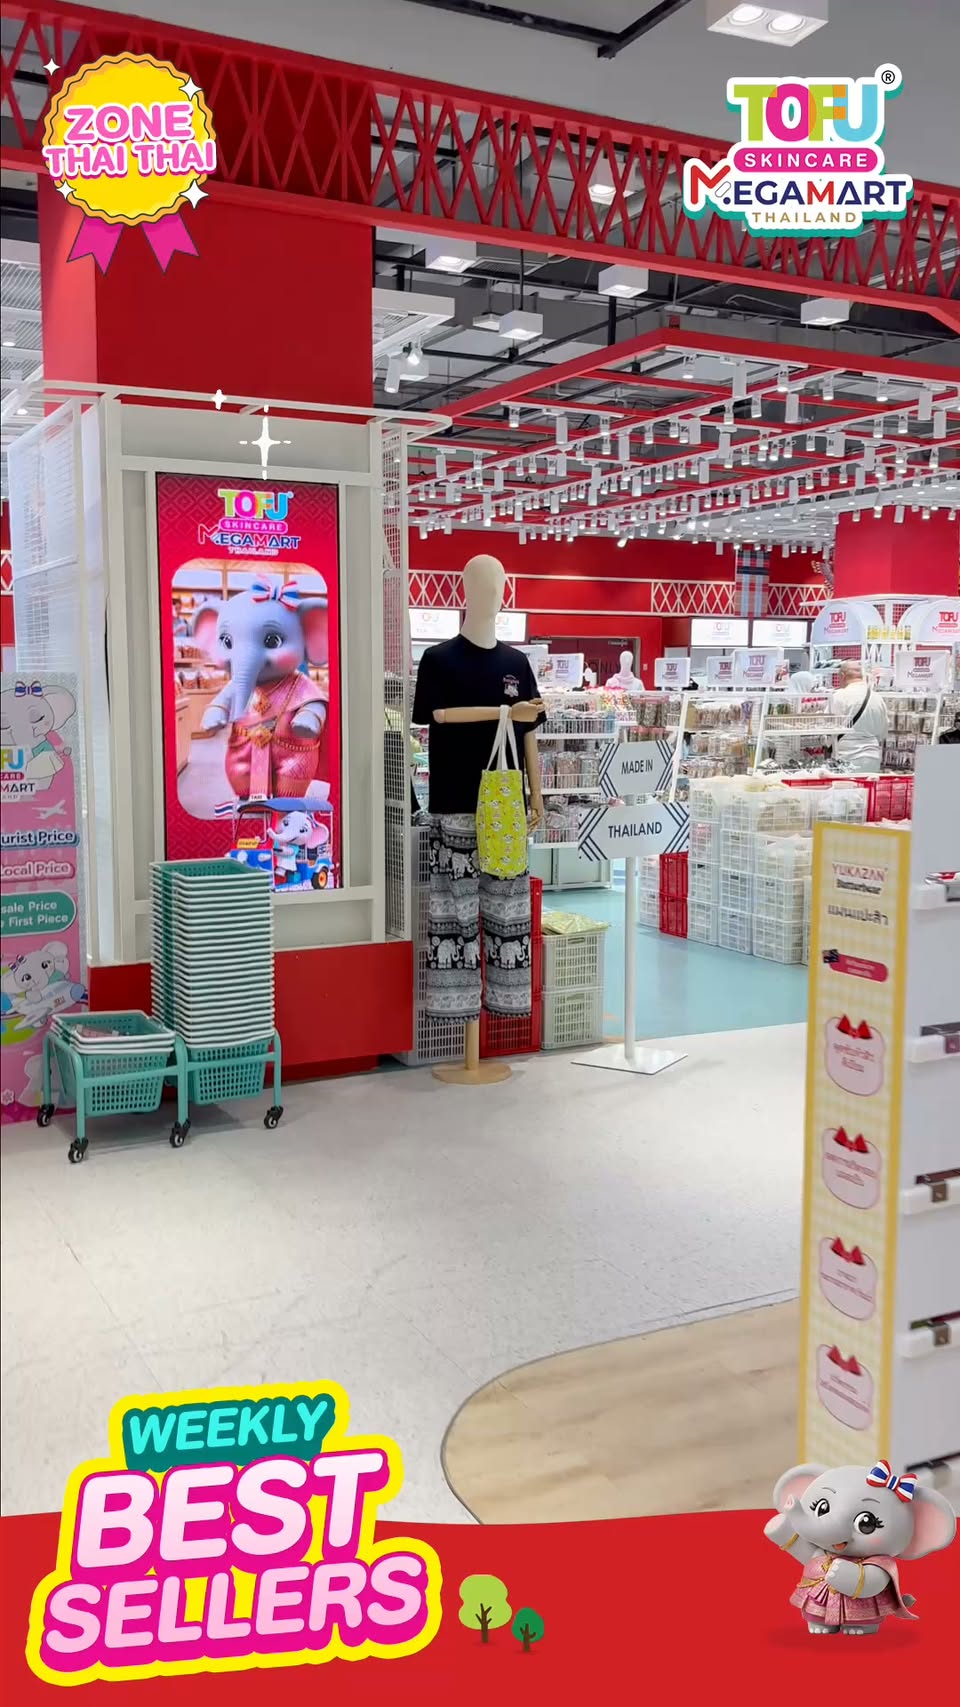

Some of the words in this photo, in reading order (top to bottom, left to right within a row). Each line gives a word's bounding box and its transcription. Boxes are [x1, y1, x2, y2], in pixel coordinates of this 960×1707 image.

[218, 489, 289, 521] TOFU
[224, 521, 283, 531] SKINCARE
[198, 523, 301, 548] MEGAMART
[621, 760, 645, 774] MADE
[645, 759, 654, 771] IN
[38, 830, 73, 842] Price
[608, 822, 663, 838] THAILAND
[36, 861, 70, 874] Price
[831, 863, 885, 882] YUKAZAN
[28, 901, 57, 911] Price
[9, 916, 33, 927] First
[37, 915, 68, 924] Piece
